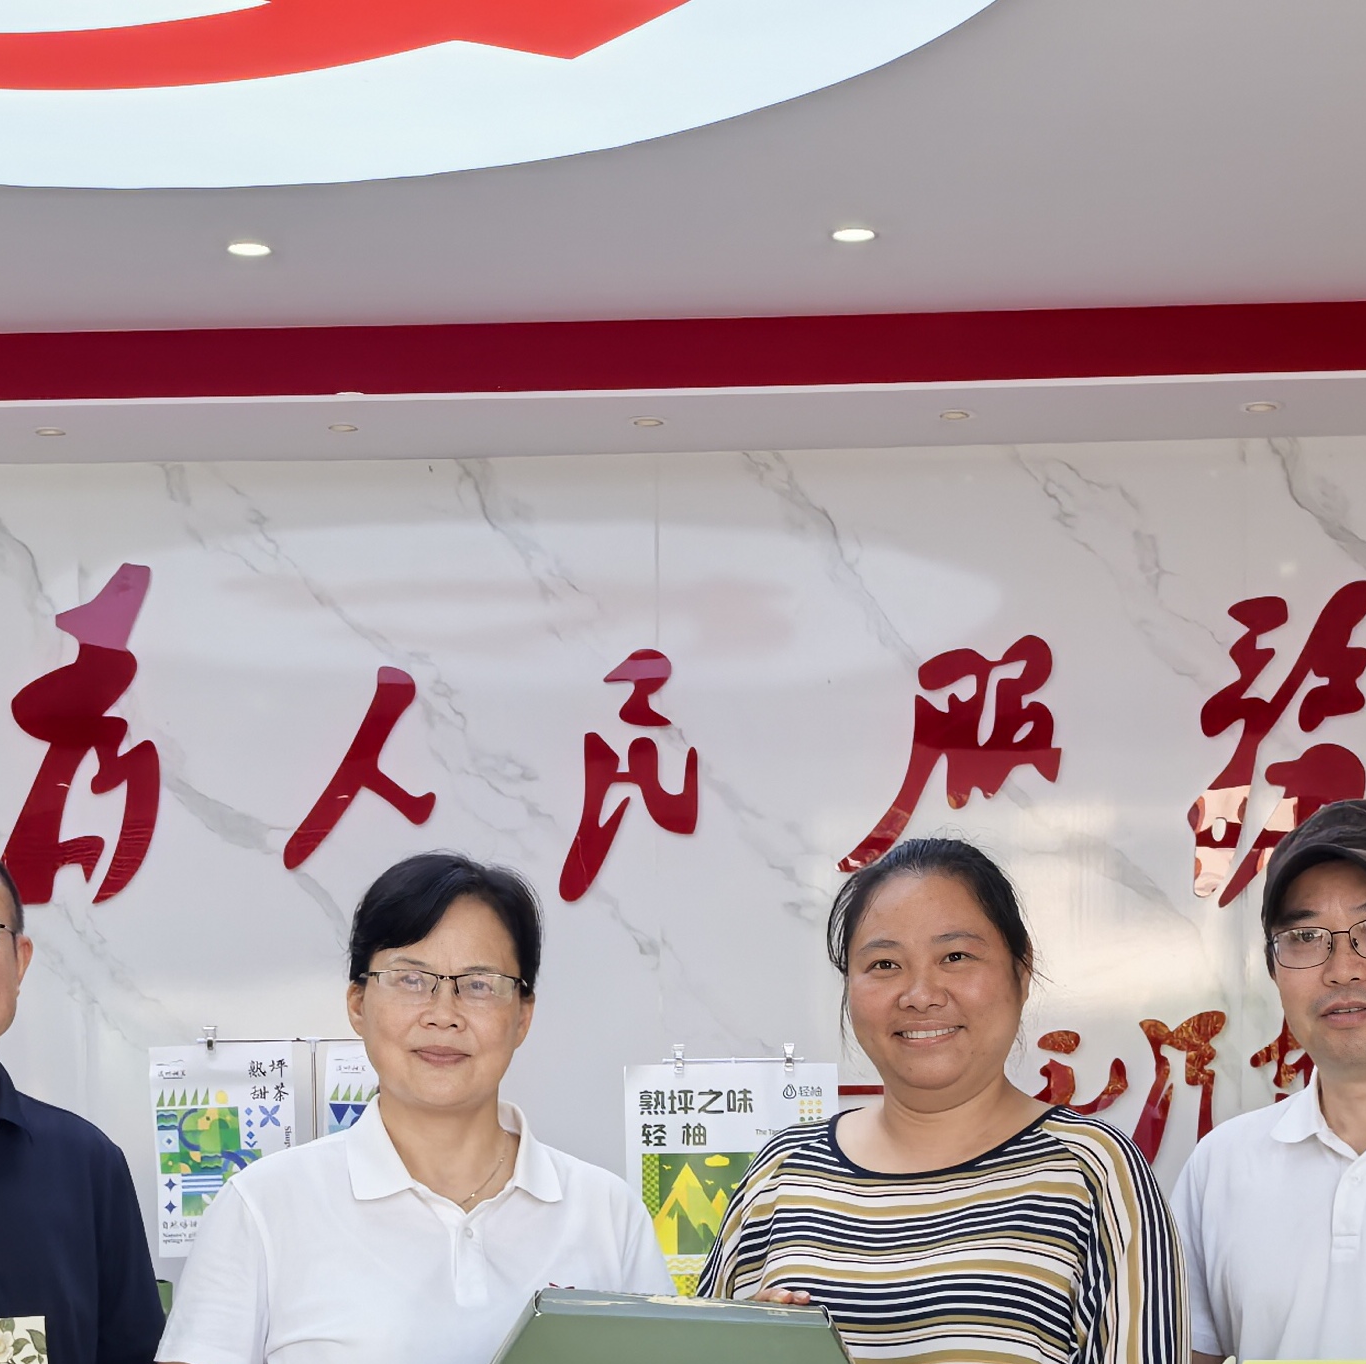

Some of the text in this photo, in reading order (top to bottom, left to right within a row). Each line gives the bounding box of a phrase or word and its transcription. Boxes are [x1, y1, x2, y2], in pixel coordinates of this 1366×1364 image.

[248, 1059, 288, 1079] 熟坪
[250, 1082, 289, 1101] 甜茶
[639, 1088, 754, 1115] 熟坪之味
[798, 1086, 823, 1097] 轻柚
[284, 1126, 292, 1149] Shup
